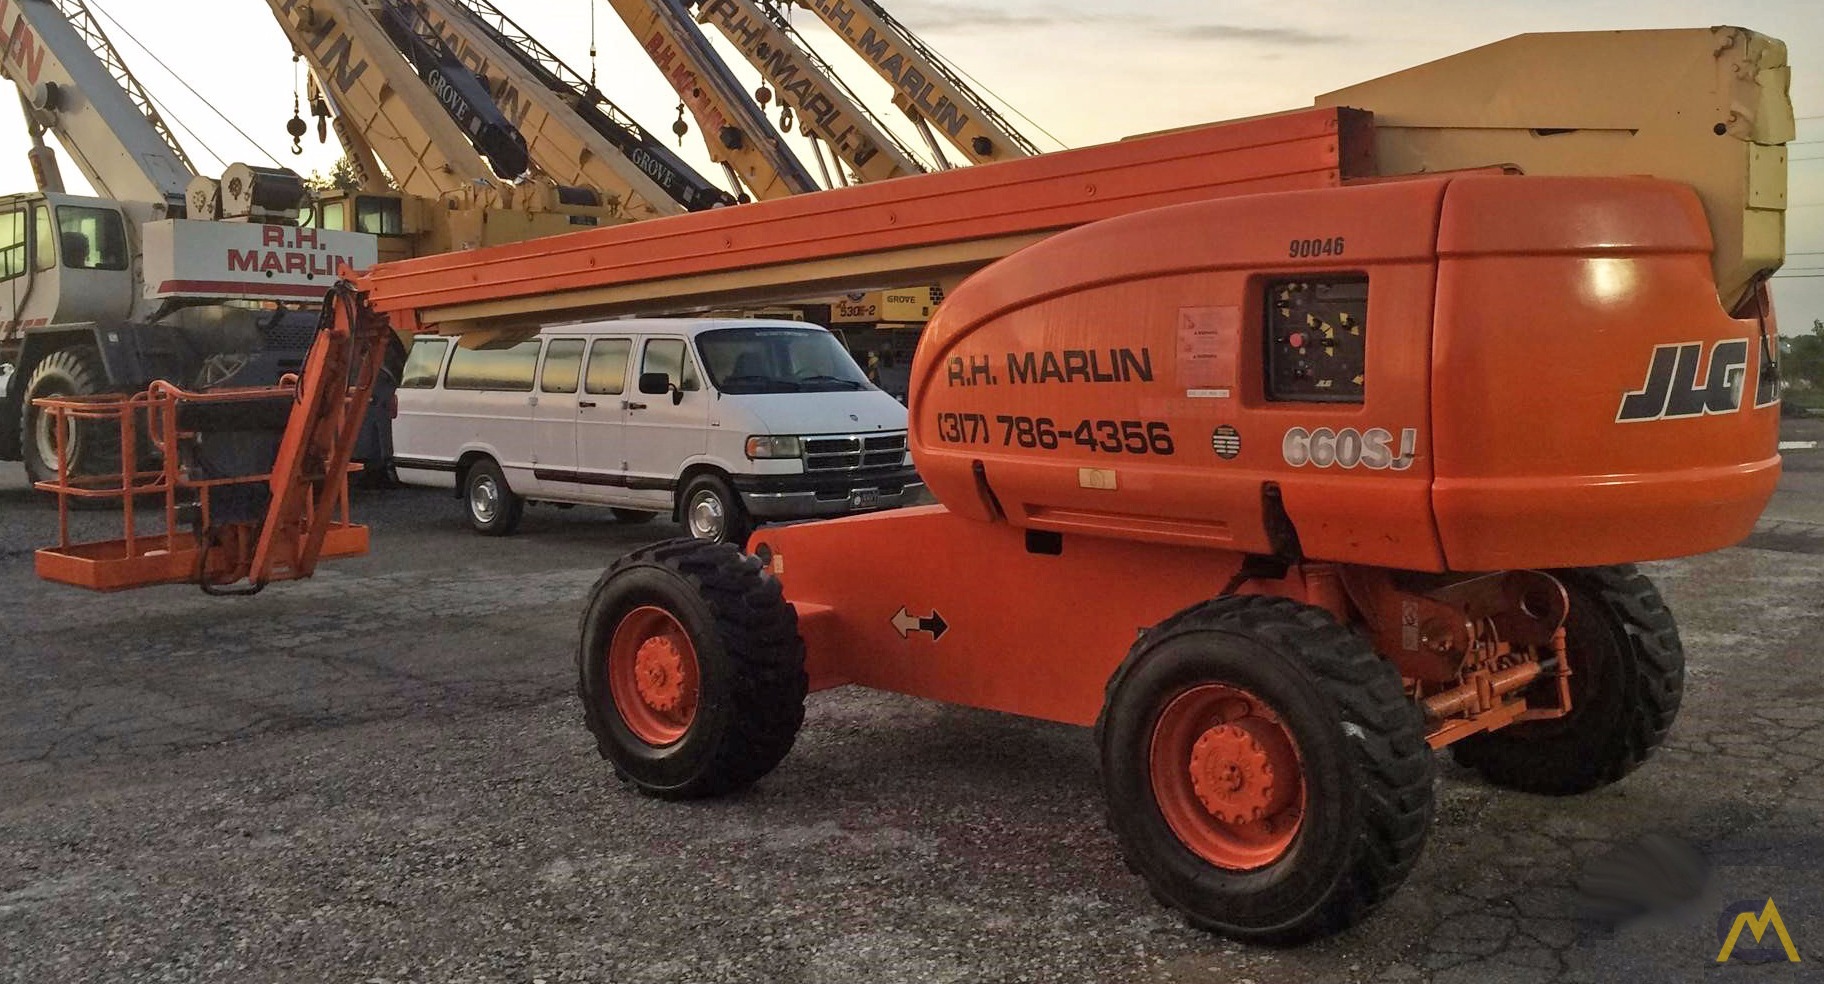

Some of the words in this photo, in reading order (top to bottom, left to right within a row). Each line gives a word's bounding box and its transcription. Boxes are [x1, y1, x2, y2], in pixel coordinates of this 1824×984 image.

[428, 69, 468, 121] GROVE
[857, 26, 970, 138] MARLIN
[631, 147, 677, 188] GROVE
[262, 225, 327, 251] R.H.
[1289, 236, 1345, 258] 90046
[227, 248, 355, 277] MARLIN
[886, 295, 917, 304] GROVE
[947, 354, 998, 387] R.H.
[1007, 347, 1154, 385] MARLIN
[1615, 337, 1749, 424] JLG
[937, 412, 990, 445] (317)
[996, 415, 1175, 455] 786-4356
[1281, 426, 1418, 471] 660SJ
